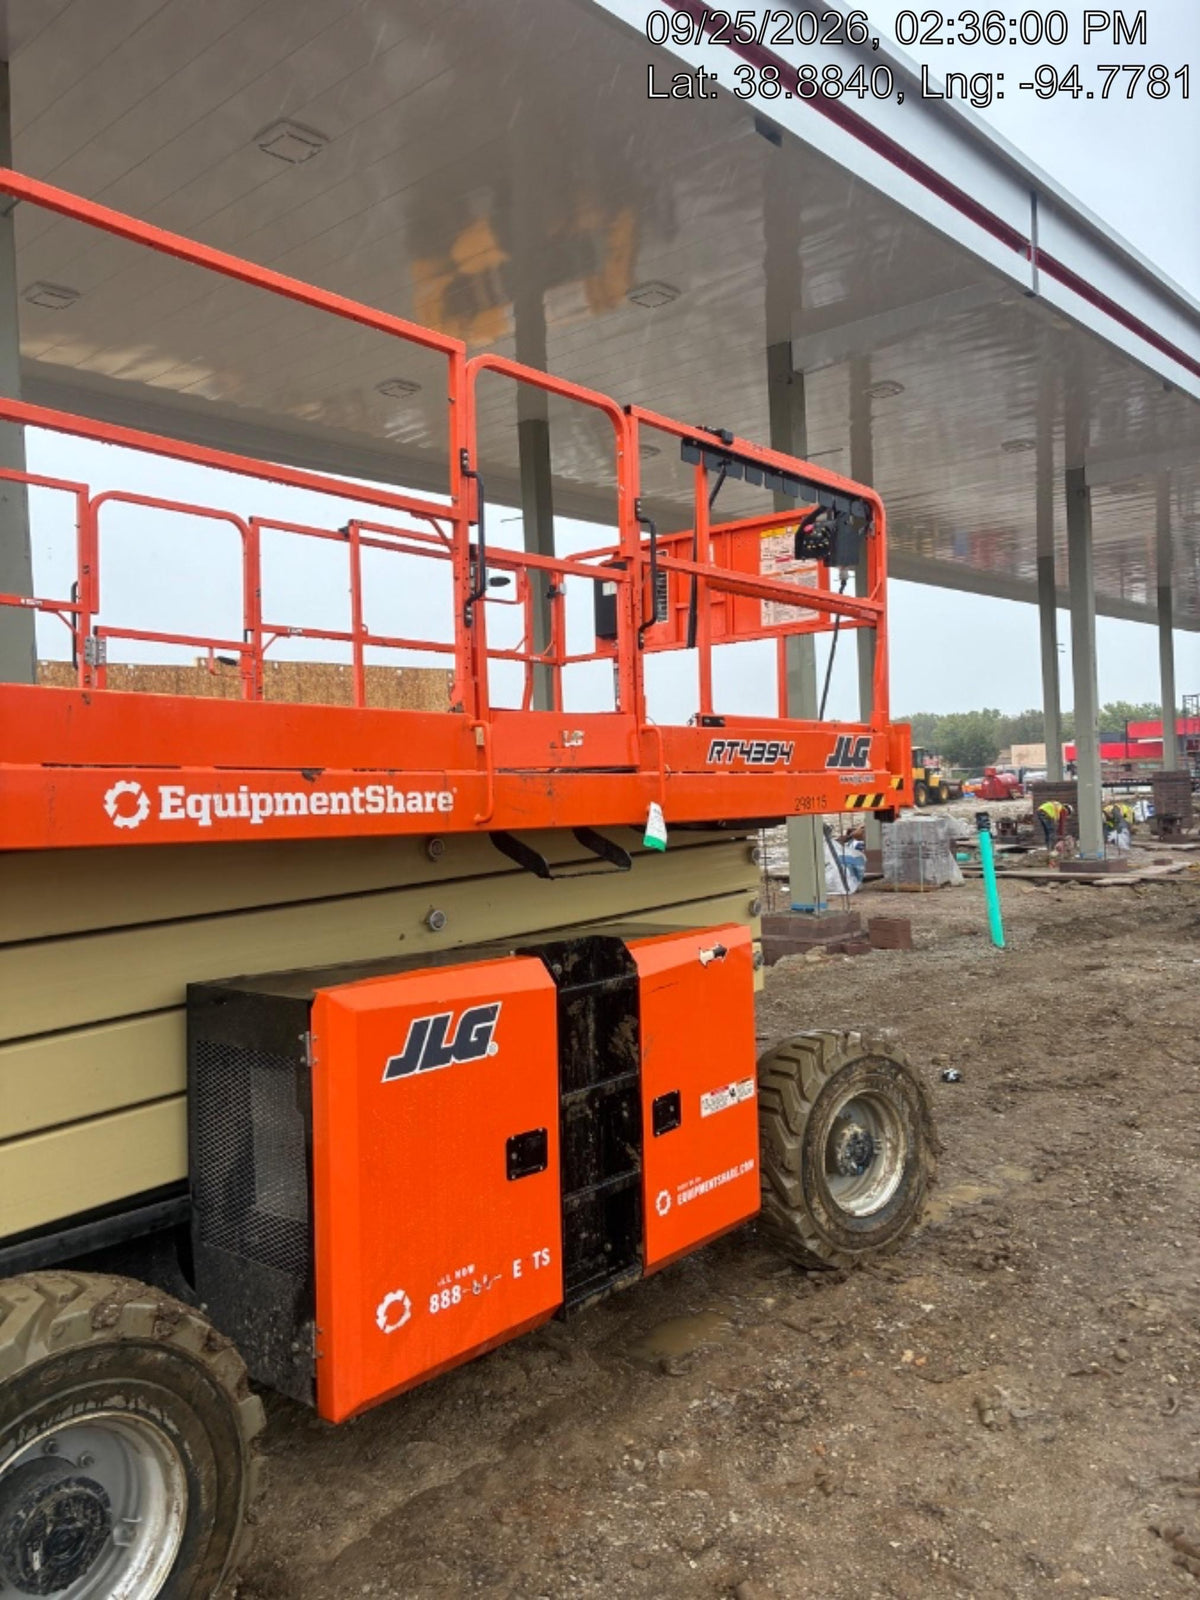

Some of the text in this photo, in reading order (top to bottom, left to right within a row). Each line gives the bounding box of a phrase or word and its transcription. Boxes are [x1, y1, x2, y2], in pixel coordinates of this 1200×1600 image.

[707, 738, 794, 766] RT4394
[825, 735, 873, 770] JLG
[158, 785, 454, 827] EquipmentShare
[381, 1001, 502, 1083] JLG
